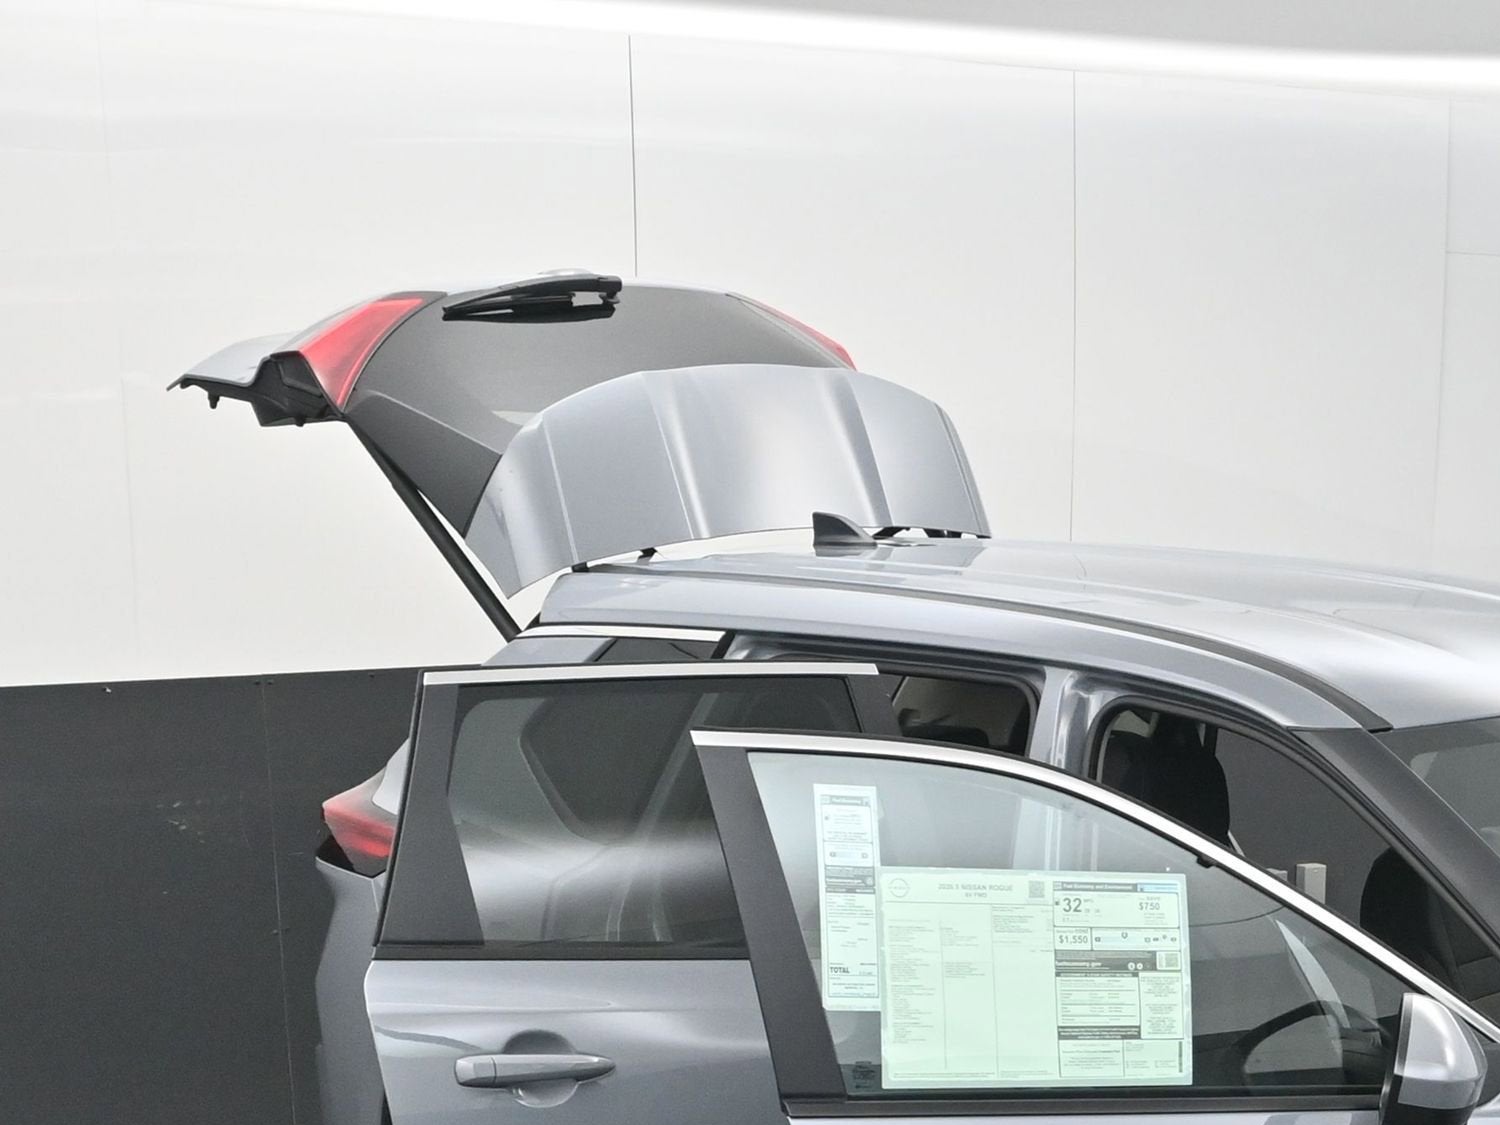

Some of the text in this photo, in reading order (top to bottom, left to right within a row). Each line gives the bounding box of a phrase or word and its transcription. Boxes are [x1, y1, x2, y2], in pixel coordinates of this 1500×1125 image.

[1063, 897, 1082, 913] 32
[1138, 902, 1160, 911] $750
[1058, 934, 1088, 944] $1,550
[830, 966, 850, 974] TOTAL
